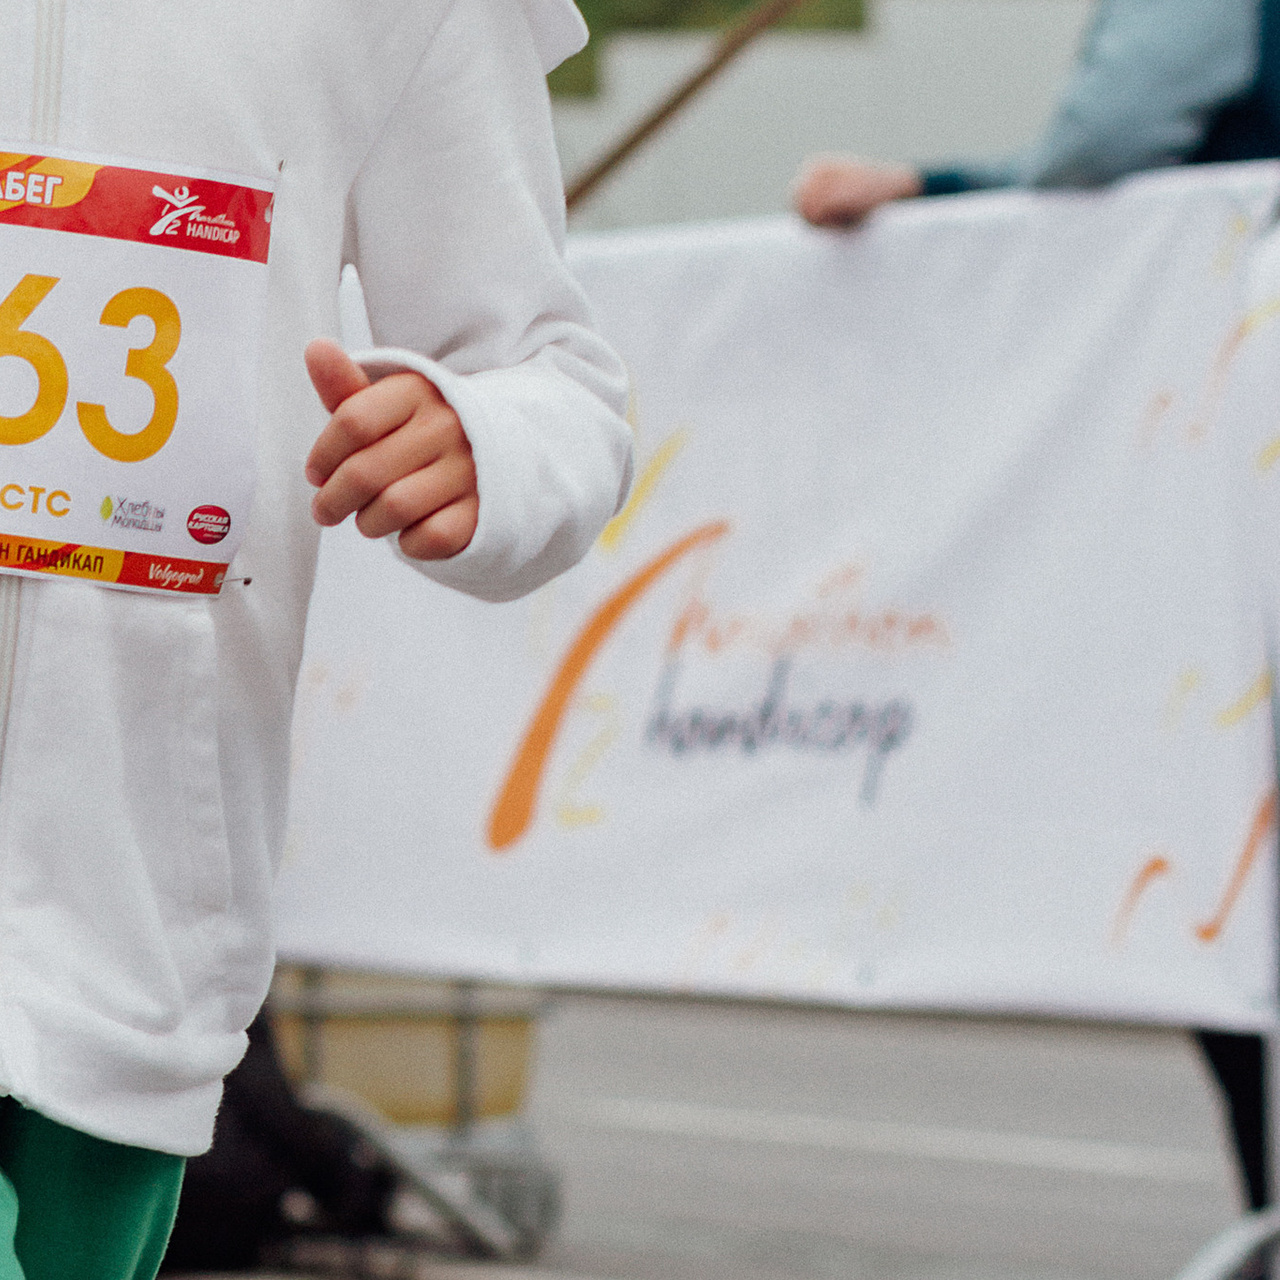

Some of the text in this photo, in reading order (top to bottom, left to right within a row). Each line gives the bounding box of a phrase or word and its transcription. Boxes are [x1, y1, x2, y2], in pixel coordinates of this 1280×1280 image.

[186, 222, 240, 244] HANDICAP
[16, 544, 104, 574] ГАНДИКАП
[148, 563, 204, 588] Volgograd
